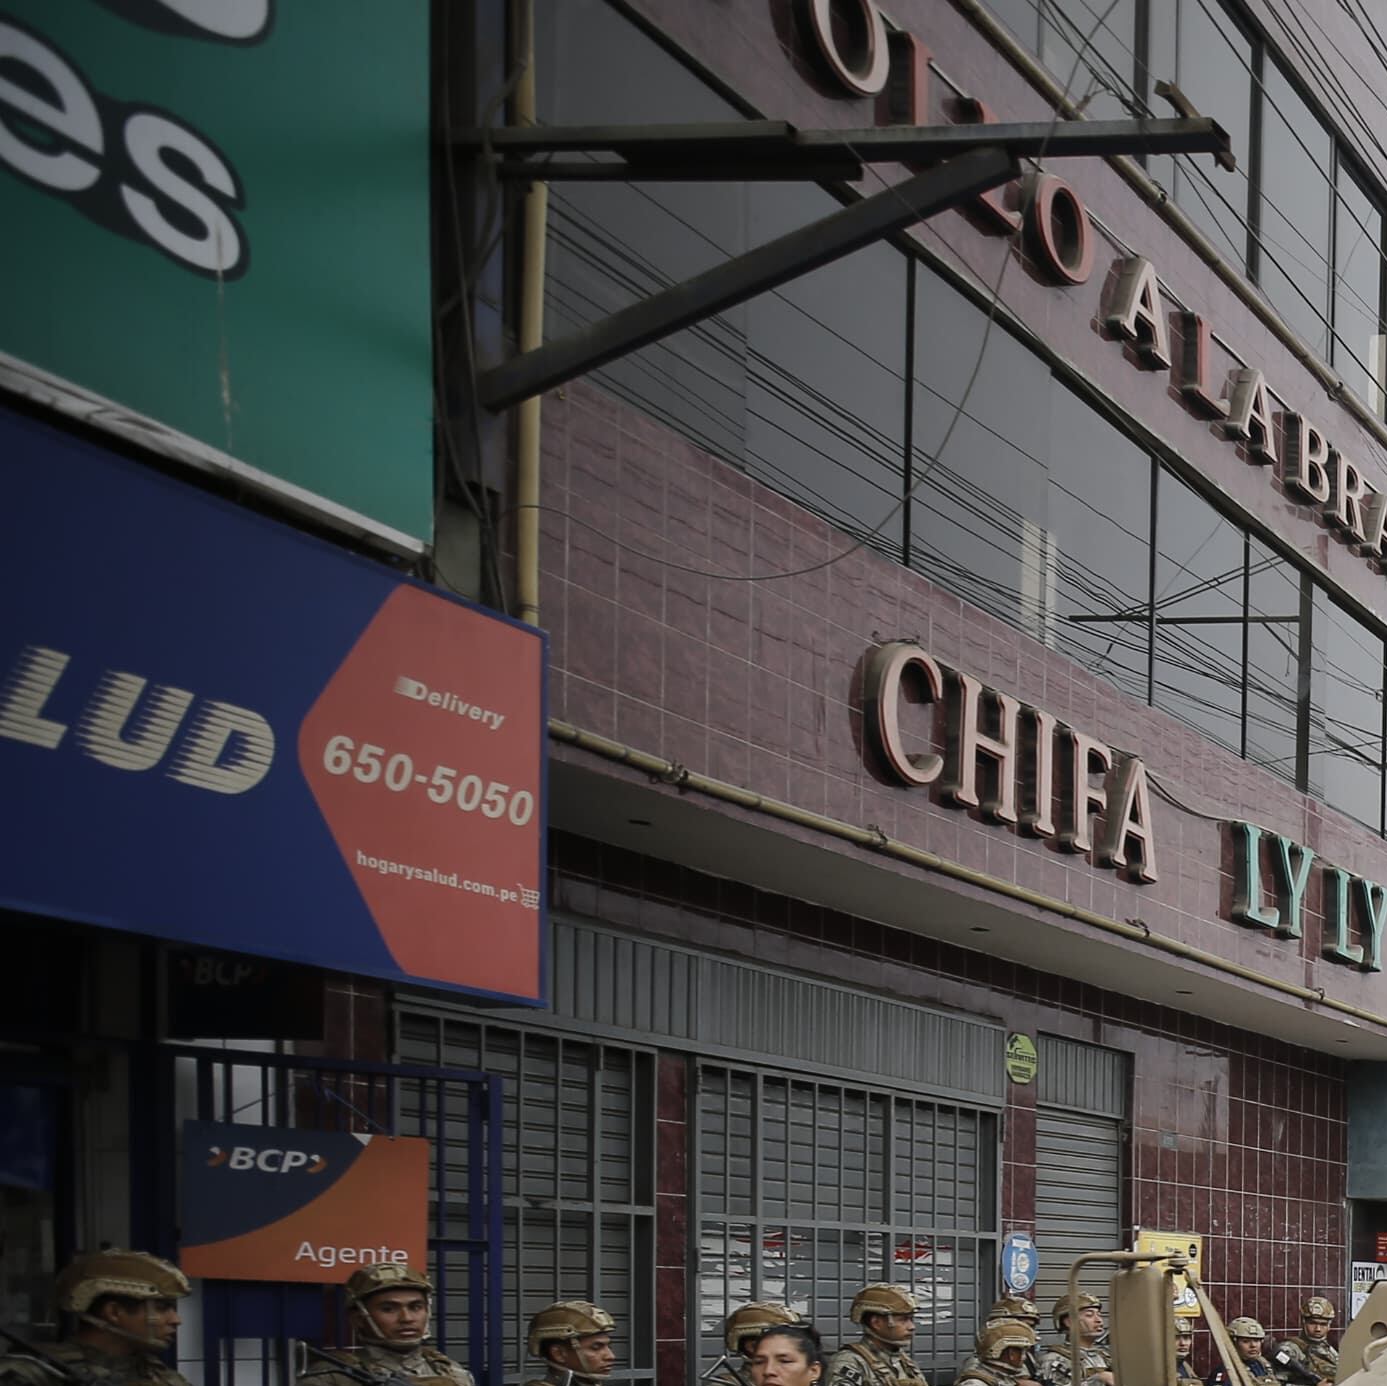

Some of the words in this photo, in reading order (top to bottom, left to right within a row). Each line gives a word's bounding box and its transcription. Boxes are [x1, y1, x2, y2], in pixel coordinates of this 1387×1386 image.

[412, 680, 505, 731] Delivery
[322, 733, 534, 828] 650-5050
[868, 641, 1160, 884] CHIFA
[1232, 822, 1314, 940] LY
[356, 850, 519, 903] hogarysalud.com.pe
[193, 957, 252, 986] BCP
[228, 1147, 308, 1174] BCP
[295, 1241, 409, 1269] Agente
[1353, 1266, 1375, 1282] DENTAL
